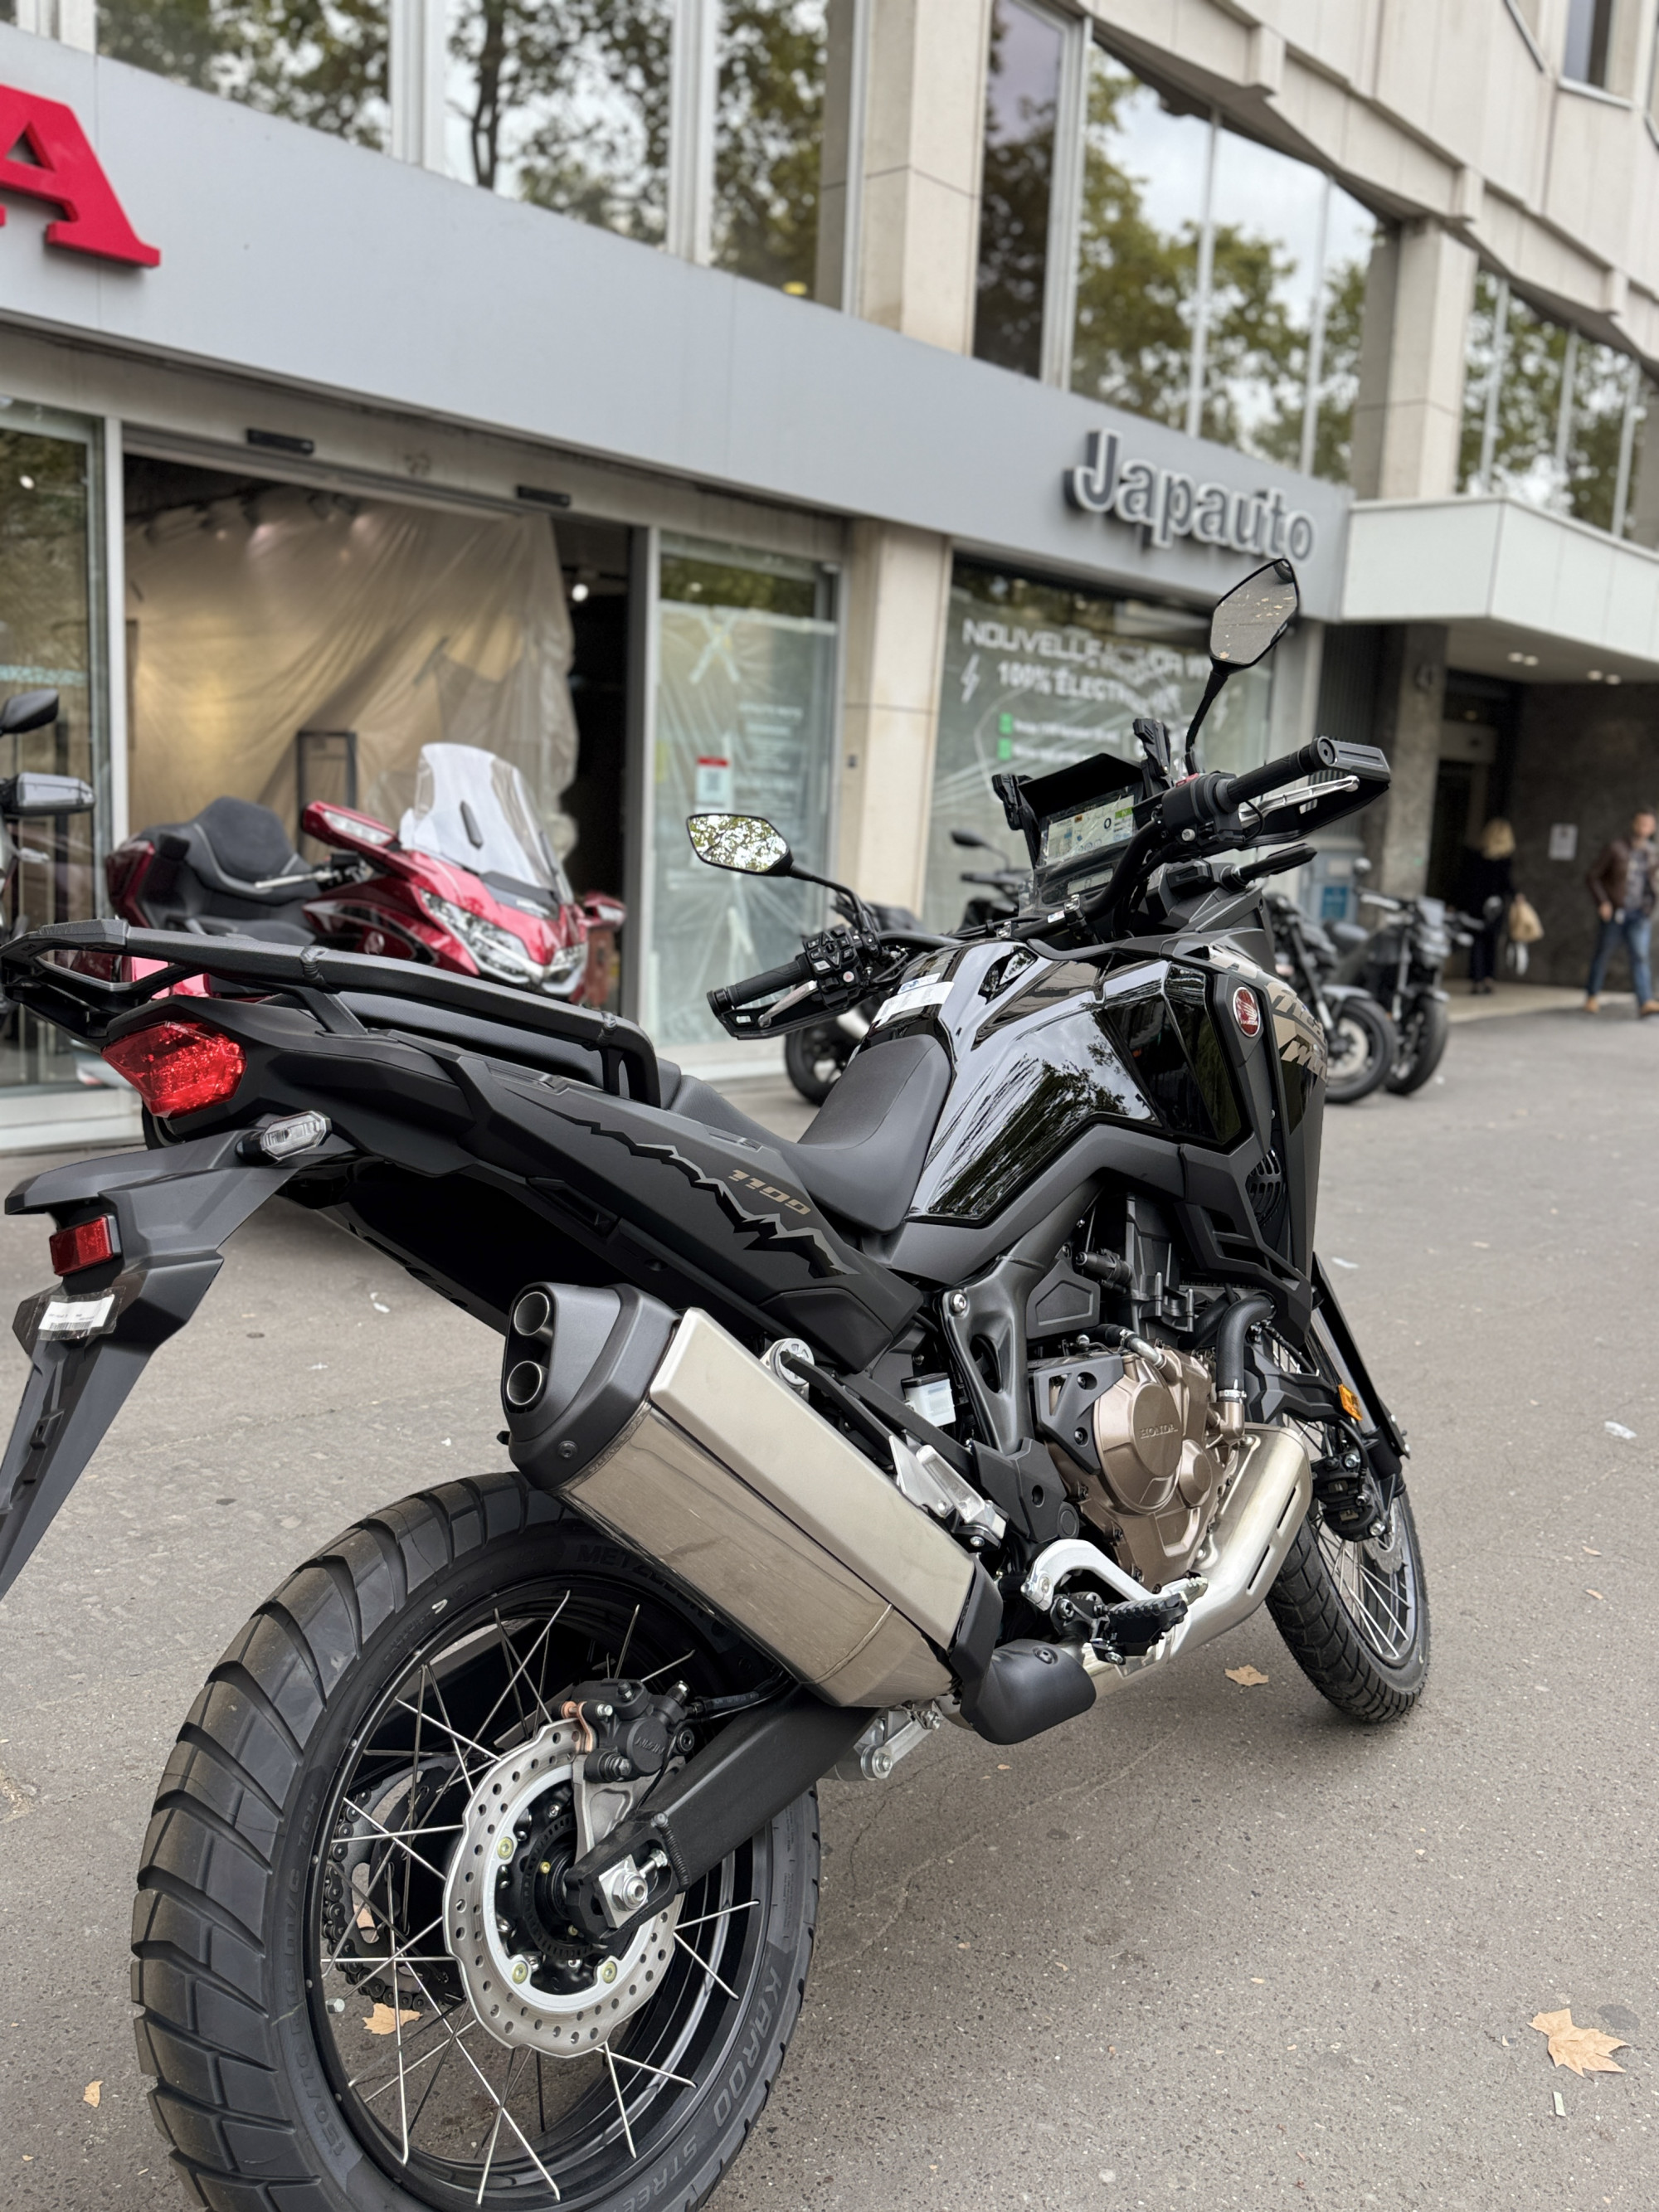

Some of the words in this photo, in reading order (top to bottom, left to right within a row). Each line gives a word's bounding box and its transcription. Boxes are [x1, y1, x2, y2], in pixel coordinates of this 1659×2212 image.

[0, 83, 161, 268] A
[1065, 430, 1316, 562] Japauto
[961, 618, 1102, 662] NOUVELLE
[997, 660, 1052, 696] 100%
[728, 1169, 810, 1215] 1100
[1139, 1422, 1179, 1440] HONDA
[713, 1966, 783, 2128] KAROO
[614, 2134, 698, 2212] STREE
